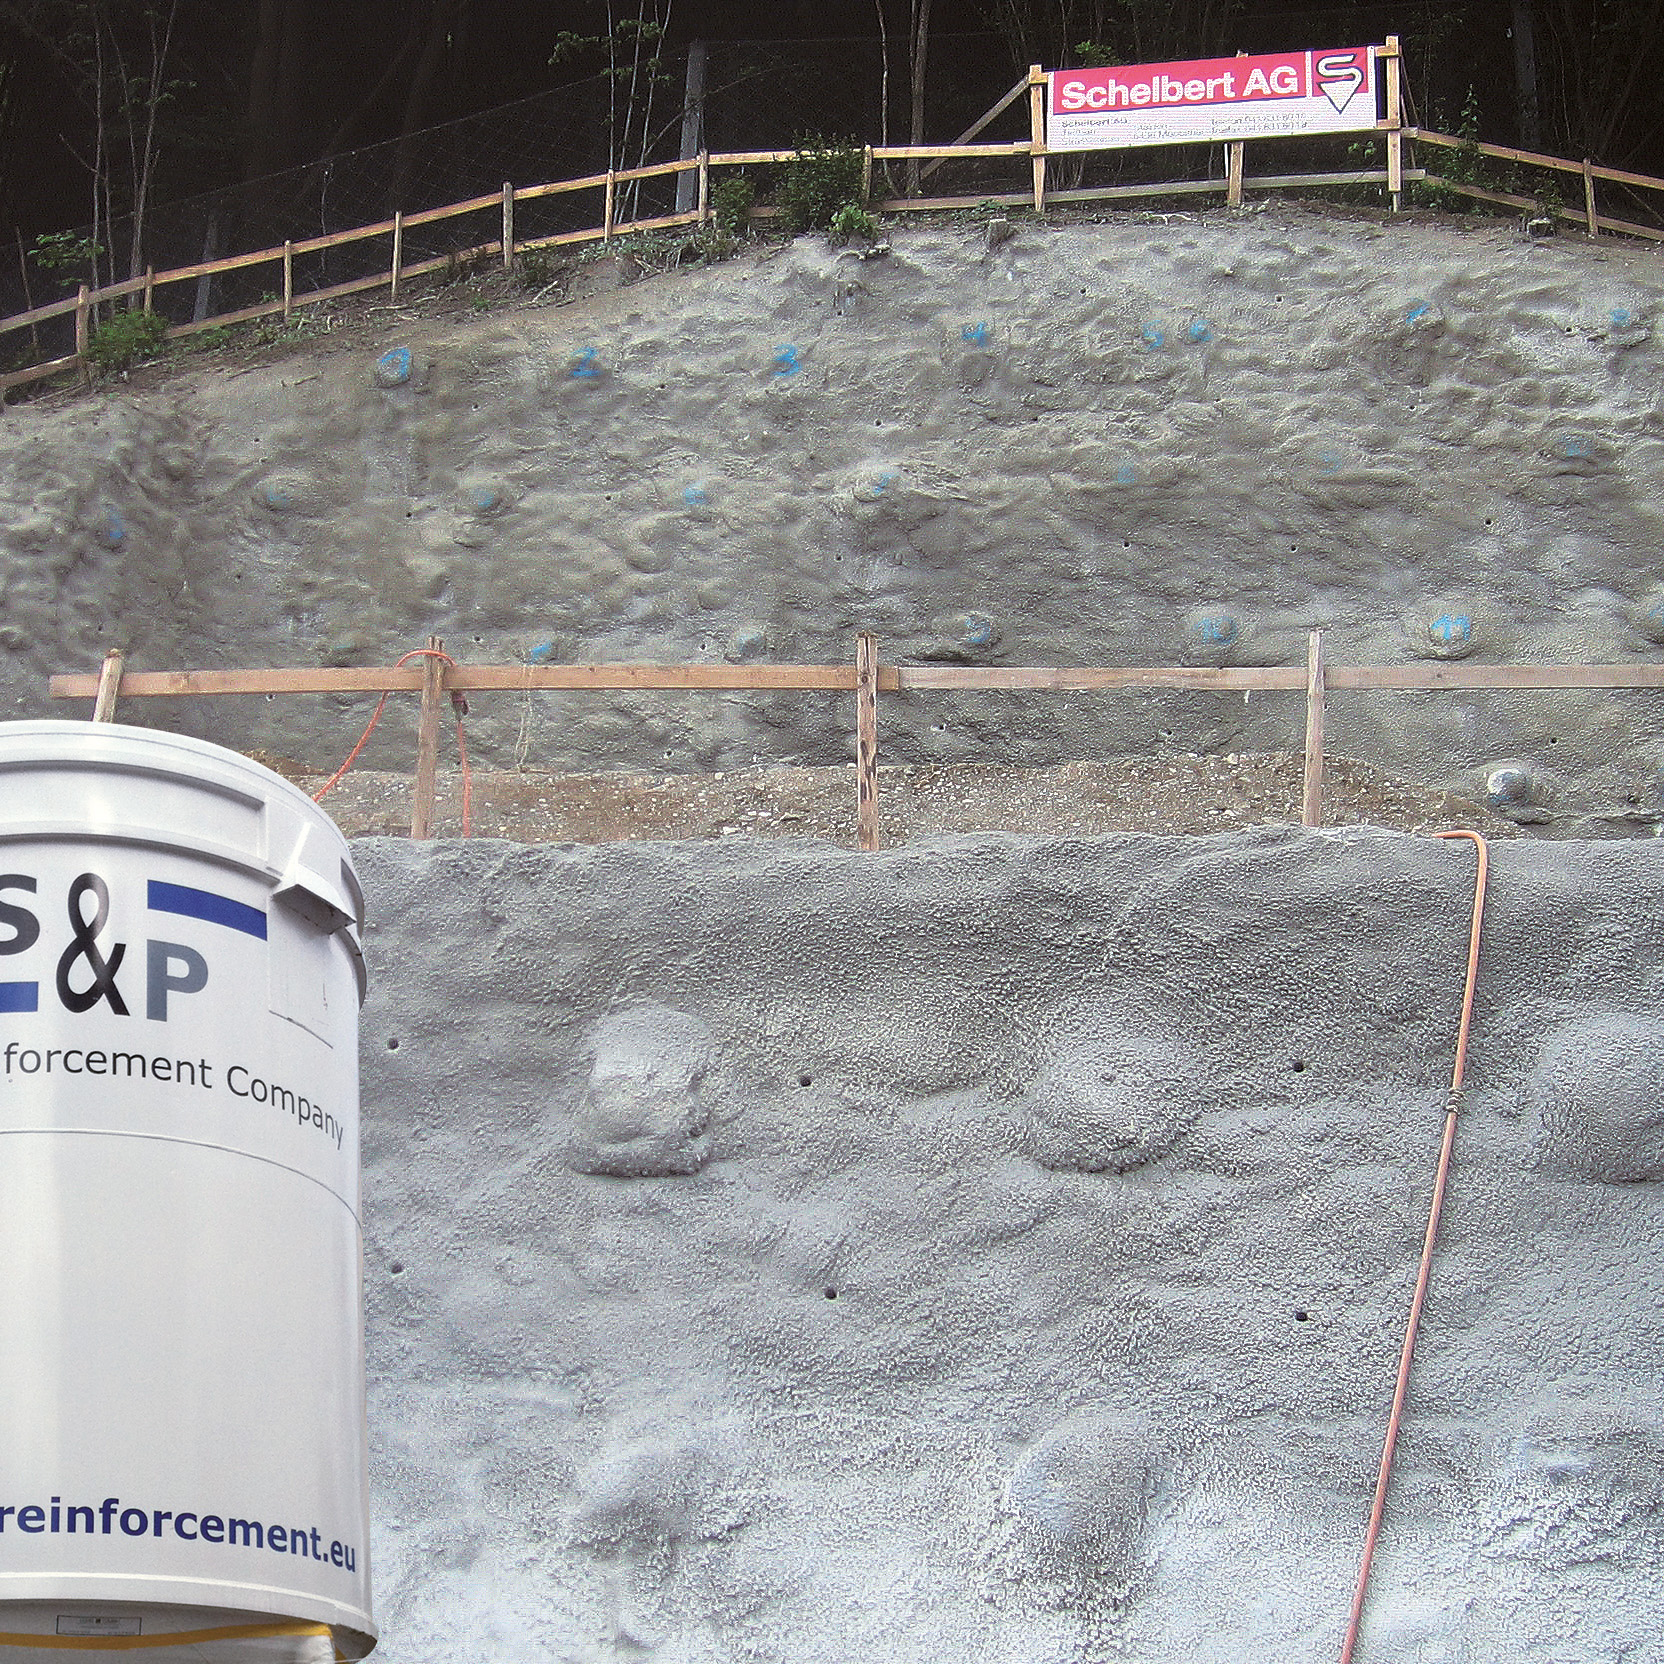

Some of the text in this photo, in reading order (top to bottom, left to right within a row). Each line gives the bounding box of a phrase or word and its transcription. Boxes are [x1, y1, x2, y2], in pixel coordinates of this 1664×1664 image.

[1061, 65, 1299, 110] Schelbert AG
[571, 346, 601, 377] 2
[772, 344, 803, 377] 3
[0, 872, 209, 1022] S&P
[3, 1042, 344, 1151] forcement Company
[0, 1496, 356, 1573] reinforcement.eu
